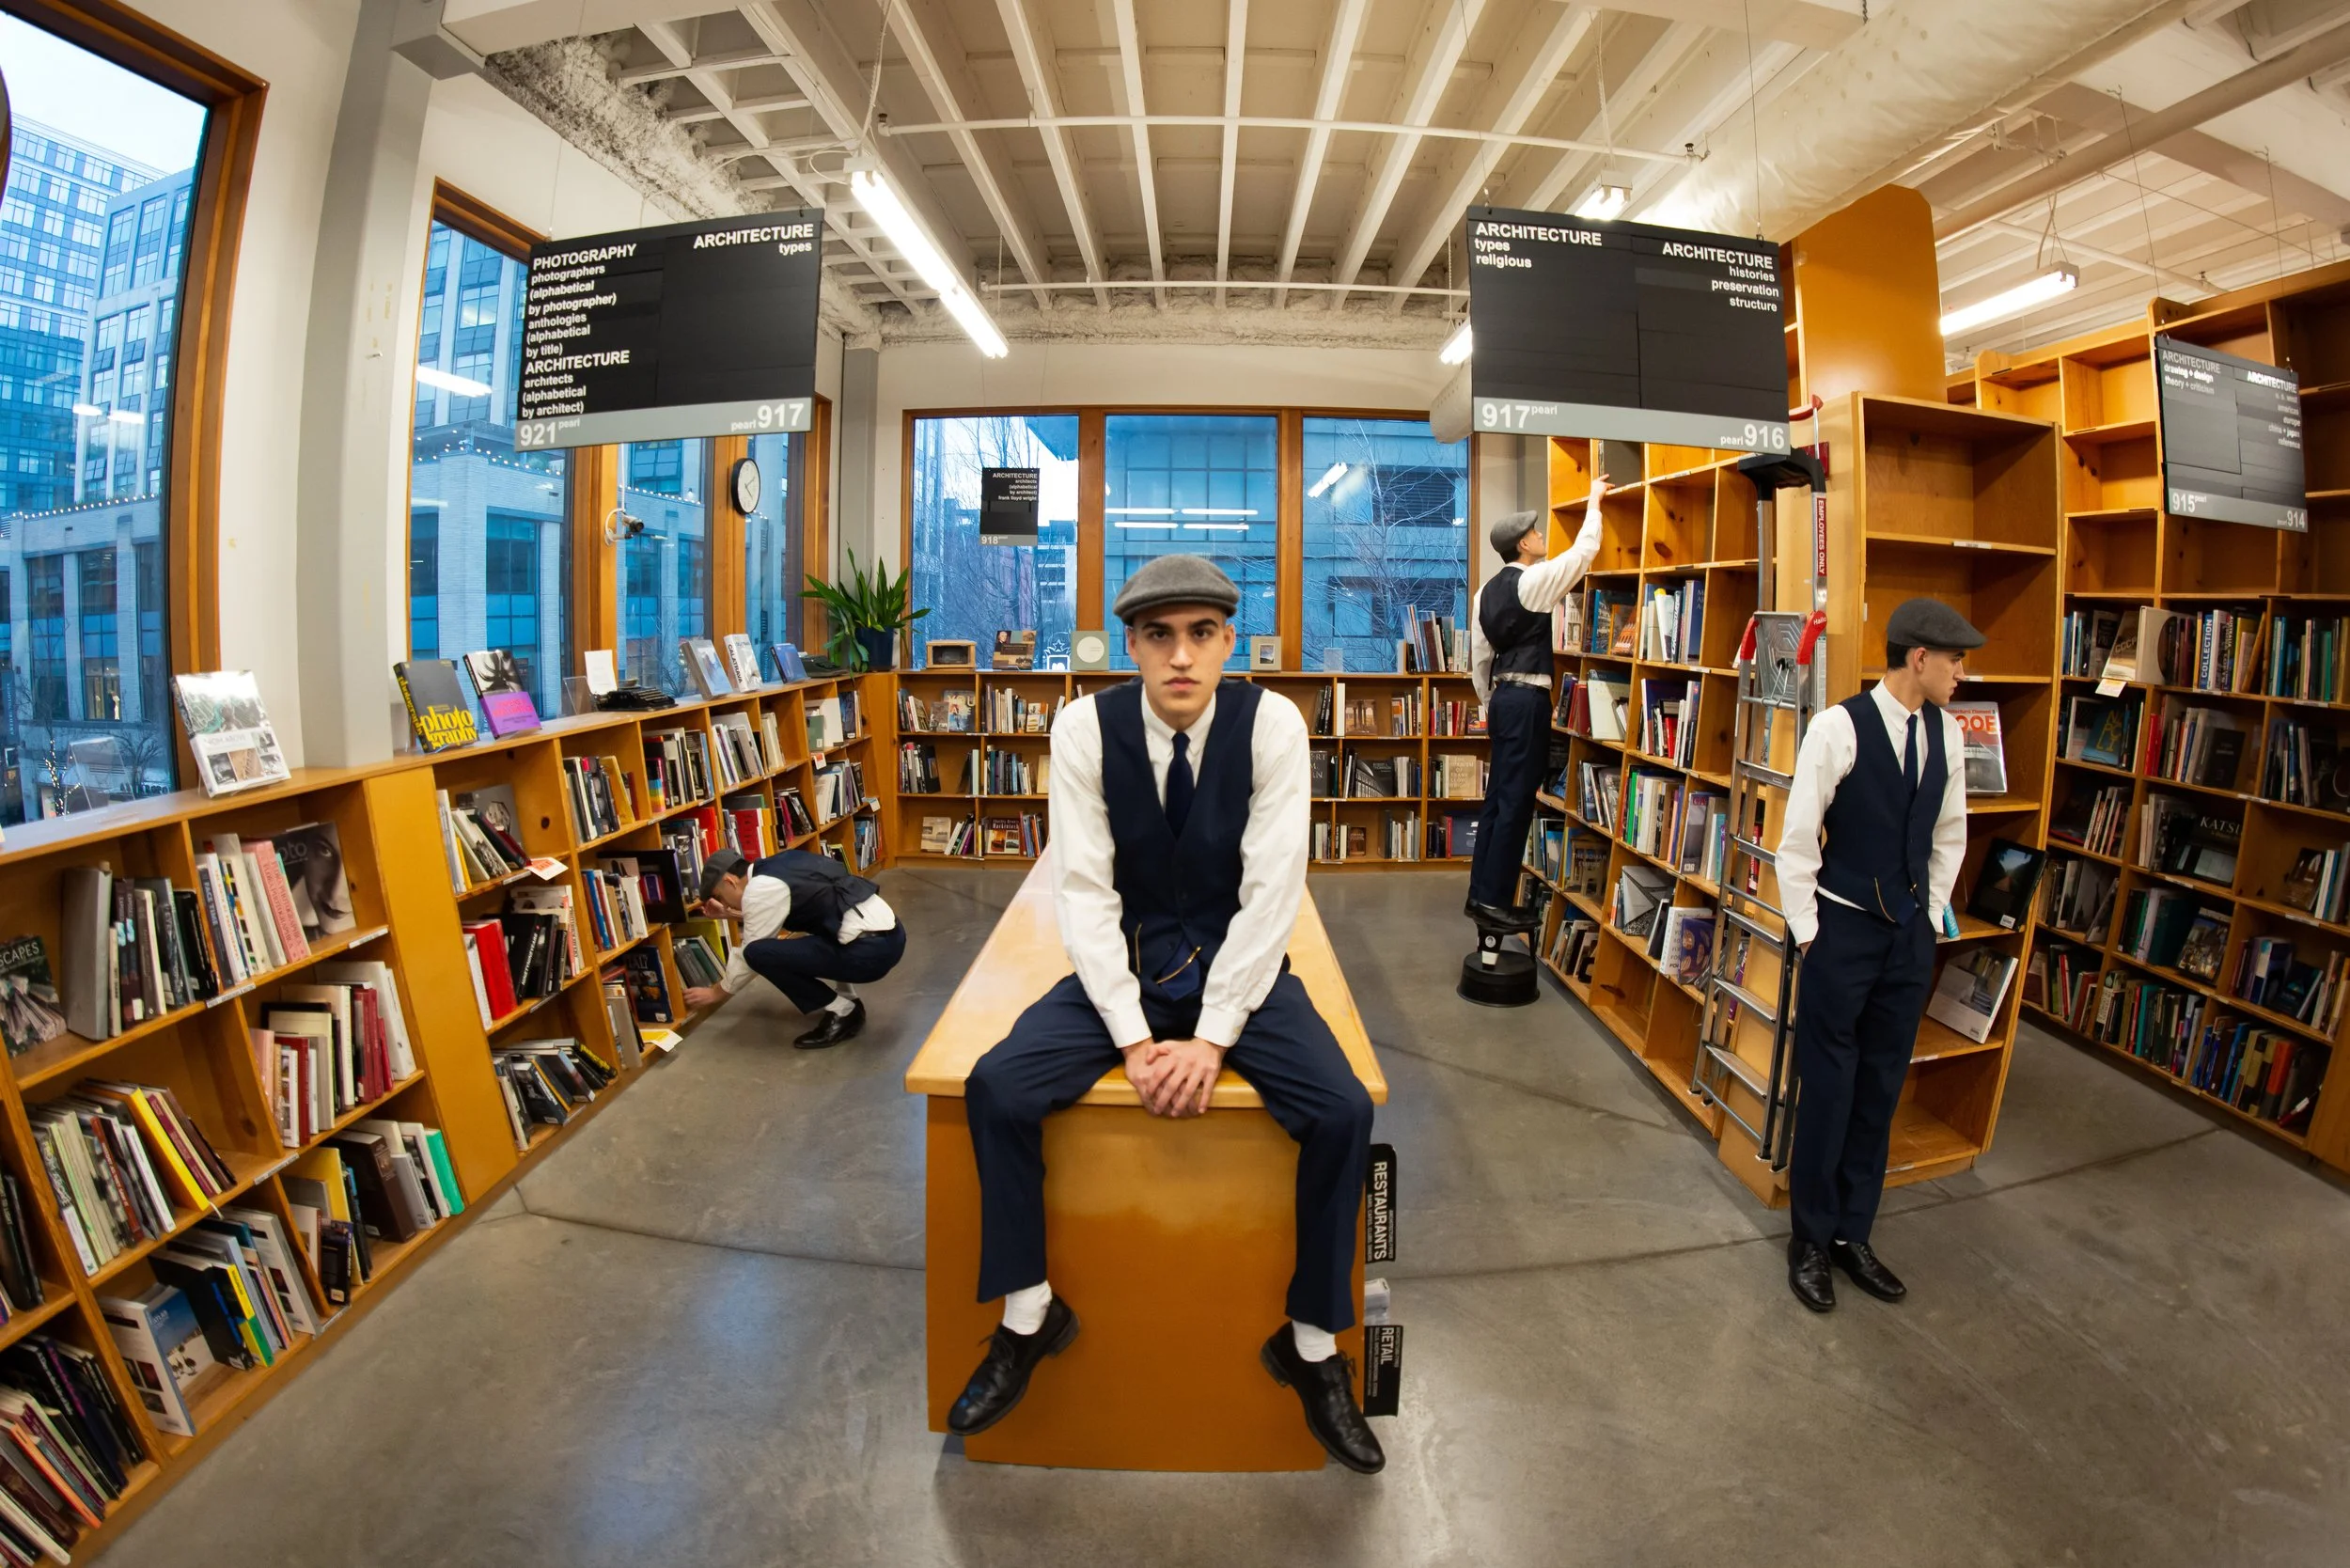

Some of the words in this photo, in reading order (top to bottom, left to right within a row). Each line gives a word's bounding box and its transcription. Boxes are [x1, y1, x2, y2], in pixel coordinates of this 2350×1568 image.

[694, 224, 814, 250] ARCHITECTURE
[1474, 238, 1511, 252] types
[1476, 222, 1602, 246] ARCHITECTURE
[533, 243, 636, 271] PHOTOGRAPHY
[779, 242, 812, 256] types
[1662, 242, 1773, 270] ARCHITECTURE
[1476, 254, 1532, 269] religious
[531, 264, 605, 286] photographers
[1729, 266, 1776, 282] histories
[529, 280, 595, 301] (alphabetical
[1712, 278, 1779, 297] preservation
[528, 302, 541, 316] by
[542, 292, 617, 315] photographer)
[1730, 296, 1778, 312] structure
[528, 313, 587, 329] anthologies
[526, 324, 590, 344] (alphabetical
[526, 346, 539, 359] by
[540, 344, 563, 357] title)
[2163, 350, 2220, 374] ARCHITECTURE
[525, 351, 630, 375] ARCHITECTURE
[2164, 364, 2188, 378] drawing
[2194, 369, 2214, 384] design
[525, 373, 573, 388] architects
[2164, 376, 2185, 390] theory
[2189, 382, 2215, 395] criticism
[2247, 370, 2297, 393] ARCHITECTURE
[522, 386, 587, 404] (alphabetical
[522, 406, 535, 419] by
[537, 401, 585, 416] architect)
[730, 419, 757, 432] pearl
[757, 403, 804, 429] 917
[1481, 402, 1530, 429] 917
[1531, 404, 1558, 416] pearl
[520, 422, 556, 447] 921
[558, 418, 580, 431] pearl
[1720, 434, 1744, 447] pearl
[1744, 423, 1785, 449] 916
[2172, 493, 2196, 513] 915
[2287, 510, 2305, 528] 914
[981, 536, 998, 544] 918
[1813, 617, 1827, 626] Hailo
[2115, 636, 2138, 653] CCCP
[2201, 619, 2213, 679] COLLECTION
[728, 644, 743, 684] CALATRAVA
[420, 706, 474, 743] photo
[430, 725, 478, 750] graphy
[202, 881, 214, 903] FACE
[207, 903, 219, 926] TIME
[0, 942, 39, 969] SCAPES
[1374, 1162, 1387, 1260] RESTAURANTS
[1381, 1327, 1394, 1365] RETAIL
